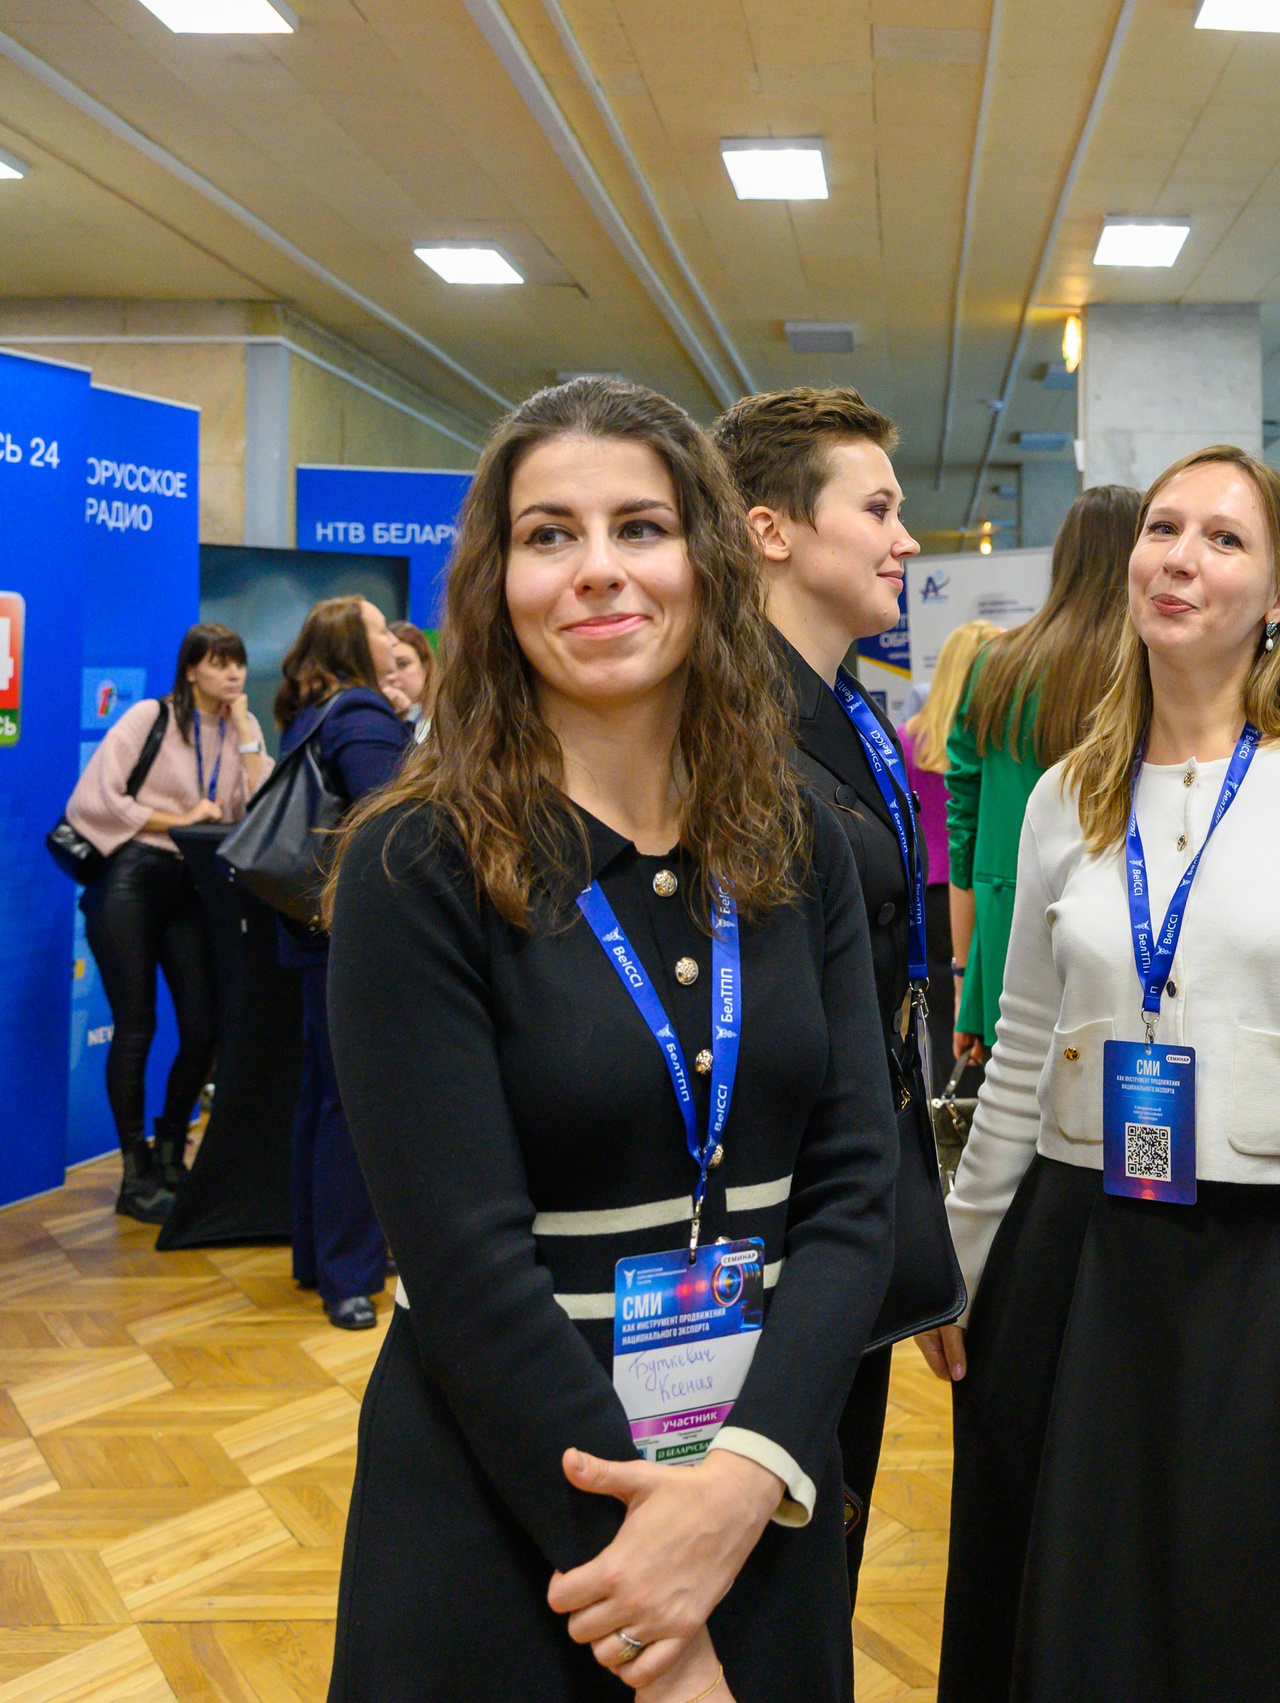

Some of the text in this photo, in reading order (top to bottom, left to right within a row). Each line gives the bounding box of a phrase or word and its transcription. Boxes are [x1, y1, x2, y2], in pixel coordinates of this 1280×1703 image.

[30, 436, 60, 469] 24
[84, 497, 153, 533] РАДИО
[315, 521, 366, 544] НТВ
[870, 730, 893, 755] BelCCI
[1238, 735, 1254, 760] BelCCI
[894, 813, 908, 853] БелТПП
[1132, 869, 1144, 896] BelCCI
[1163, 914, 1179, 945] BelCCI
[612, 946, 643, 988] BelCCI
[721, 968, 733, 1023] БелТПП
[666, 1043, 690, 1102] БелТПП
[1136, 1059, 1160, 1077] СМИ
[714, 1084, 728, 1132] BelCCI
[723, 1252, 757, 1264] СЕМИНАР
[622, 1291, 662, 1320] СМИ
[622, 1307, 726, 1333] КАК ИНСТРУМЕНТ ПРОДВИЖЕНИЯ
[622, 1322, 710, 1346] НАЦИОНАЛЬНОГО ЭКСПОРТА
[660, 1374, 713, 1403] Ксения
[663, 1411, 718, 1433] участник
[666, 1441, 713, 1458] БЕЛАРУСБА
